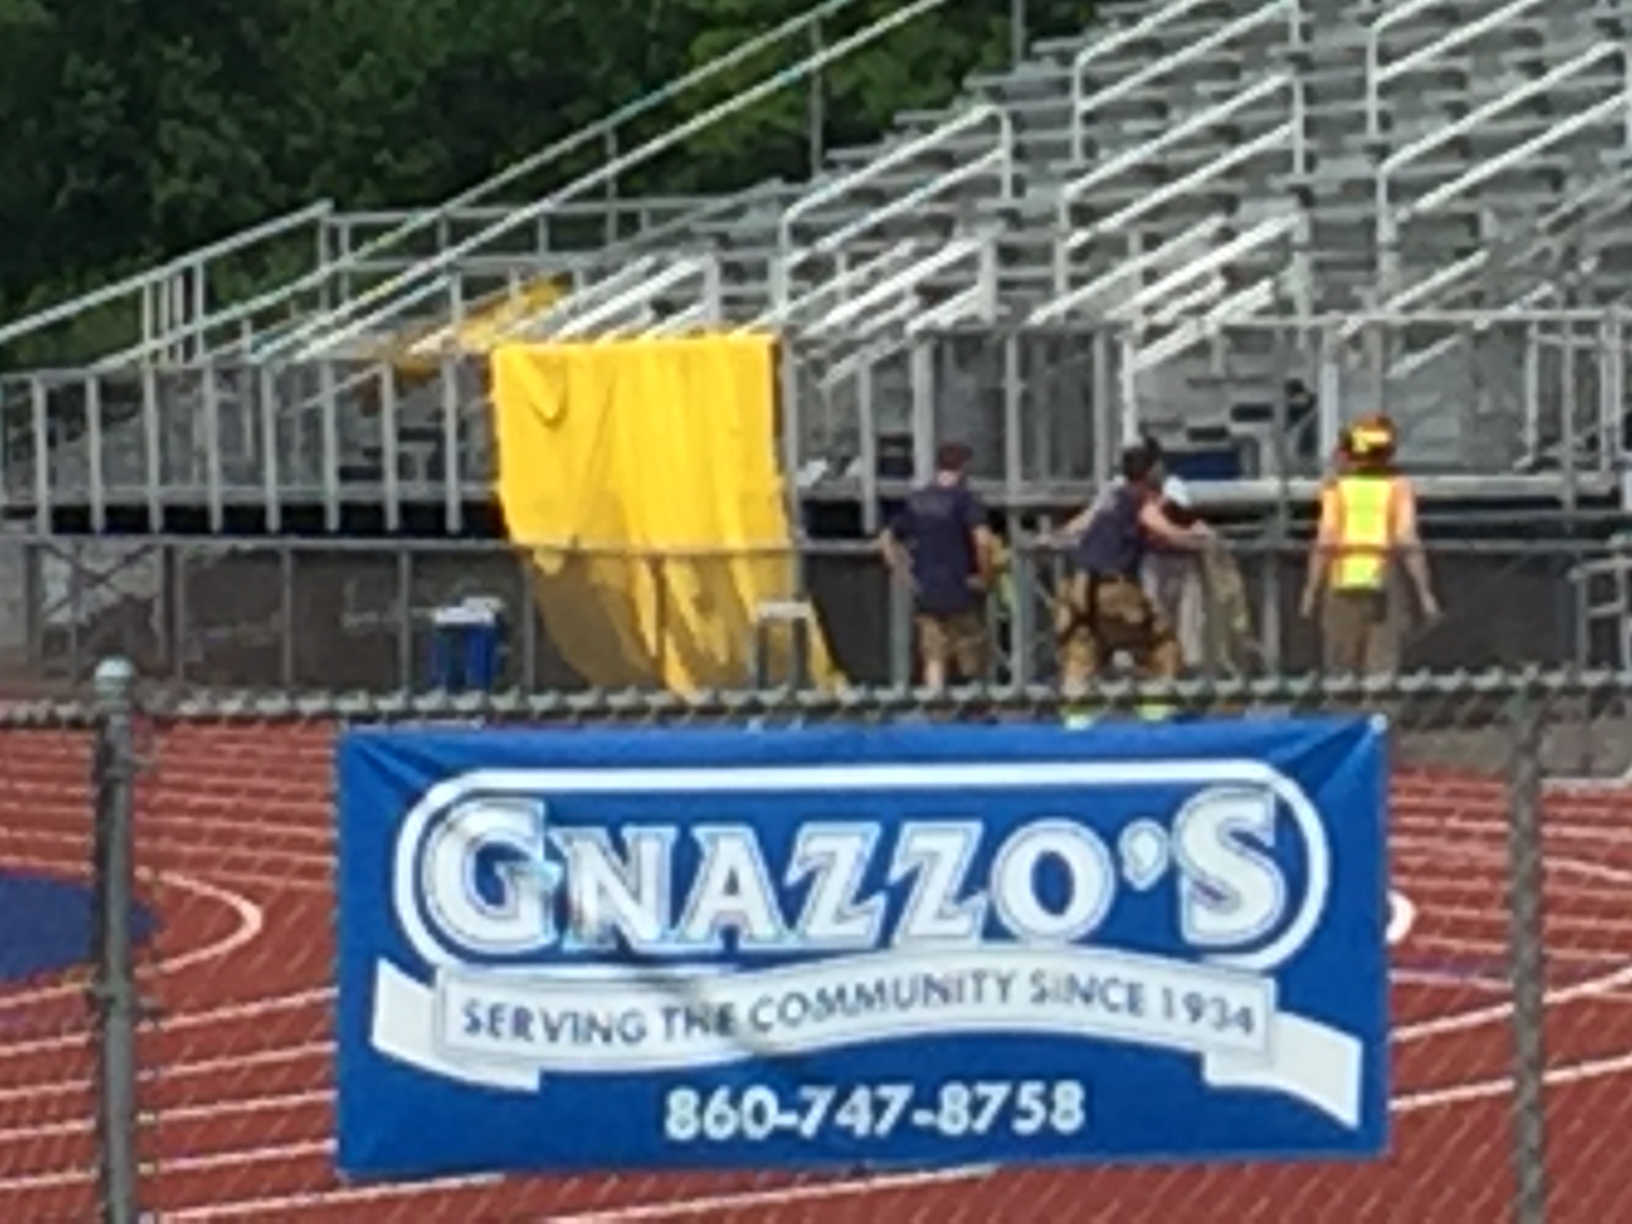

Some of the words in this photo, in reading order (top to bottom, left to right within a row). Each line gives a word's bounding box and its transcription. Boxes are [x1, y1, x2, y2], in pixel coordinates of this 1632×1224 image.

[463, 998, 648, 1044] SERVING
[660, 1002, 735, 1038] THE
[748, 970, 1016, 1032] COMMUNITY
[1030, 970, 1144, 1016] SINCE
[1160, 986, 1255, 1035] 1934
[664, 1079, 1086, 1141] 860-747-8758
